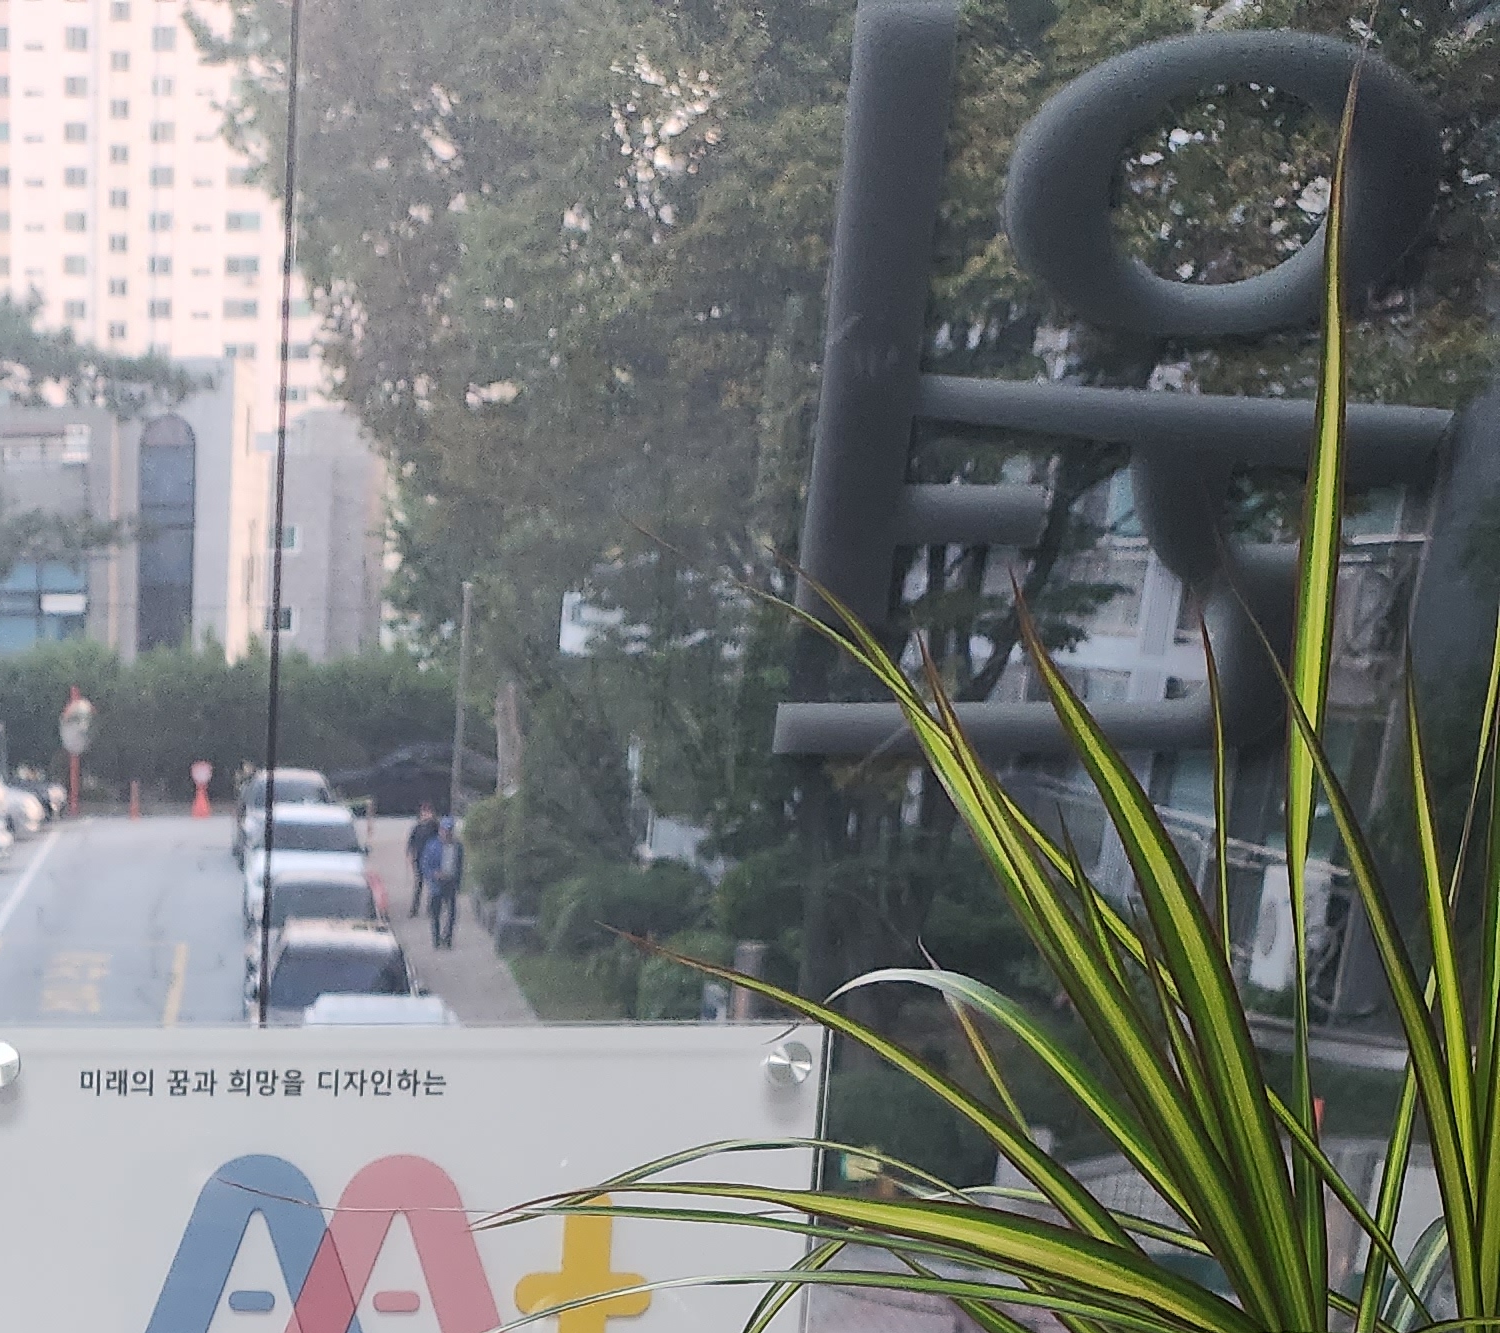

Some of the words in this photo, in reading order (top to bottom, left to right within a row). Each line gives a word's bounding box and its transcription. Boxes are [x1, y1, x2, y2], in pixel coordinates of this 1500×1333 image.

[79, 1068, 155, 1097] 미래의
[166, 1068, 219, 1098] 꿈과
[226, 1068, 306, 1098] 희망을
[316, 1068, 448, 1098] 디자인하는
